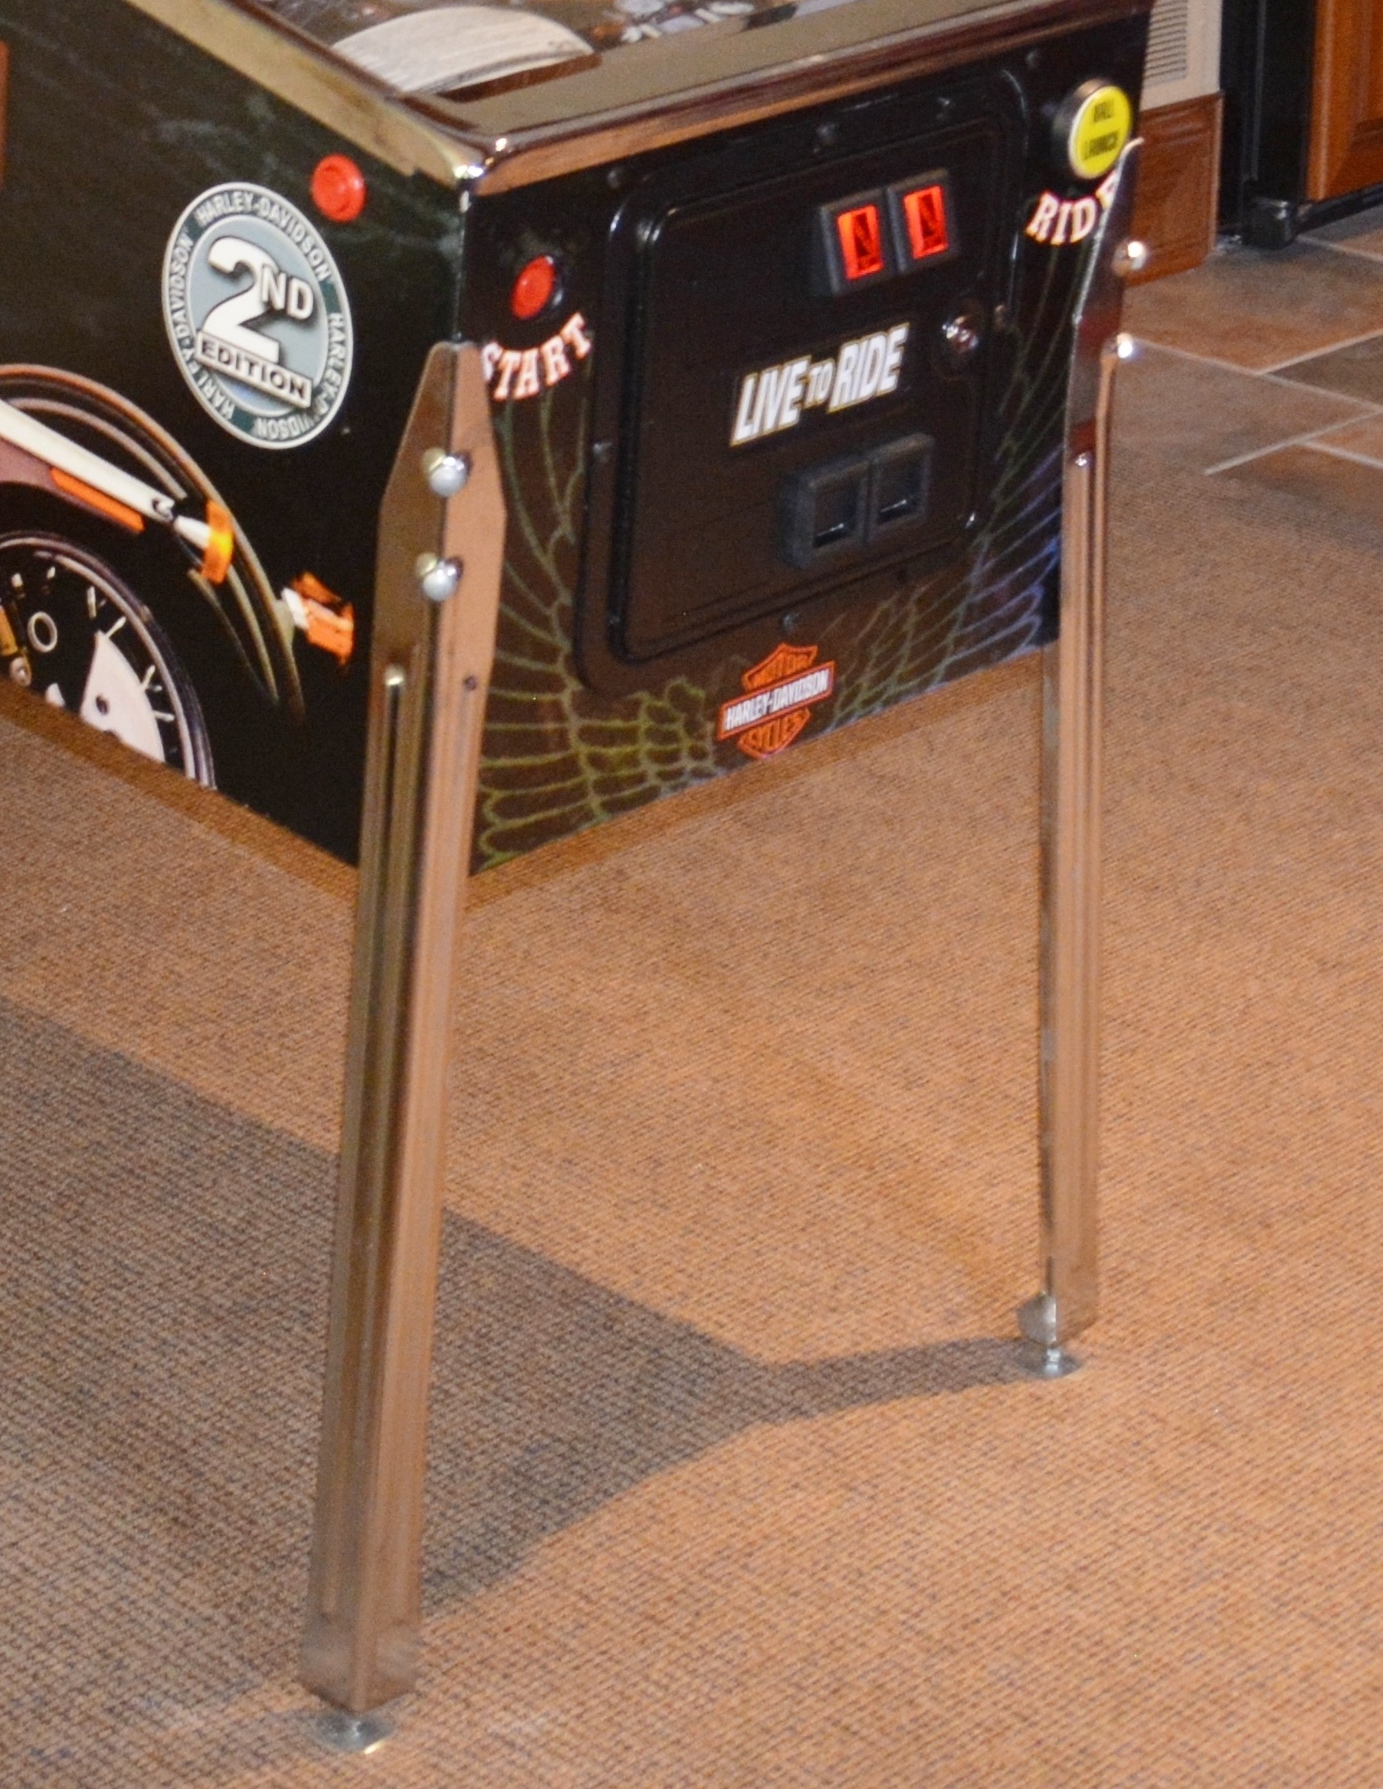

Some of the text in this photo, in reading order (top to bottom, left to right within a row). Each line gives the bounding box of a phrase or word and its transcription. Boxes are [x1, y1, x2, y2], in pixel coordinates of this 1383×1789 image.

[195, 188, 333, 283] HARLEY-DAVIDSON
[202, 236, 315, 364] 2ND
[201, 338, 308, 401] EDITION
[730, 322, 910, 447] LIVE TO RIDE
[724, 668, 830, 732] HARLEY-DAVIDSON
